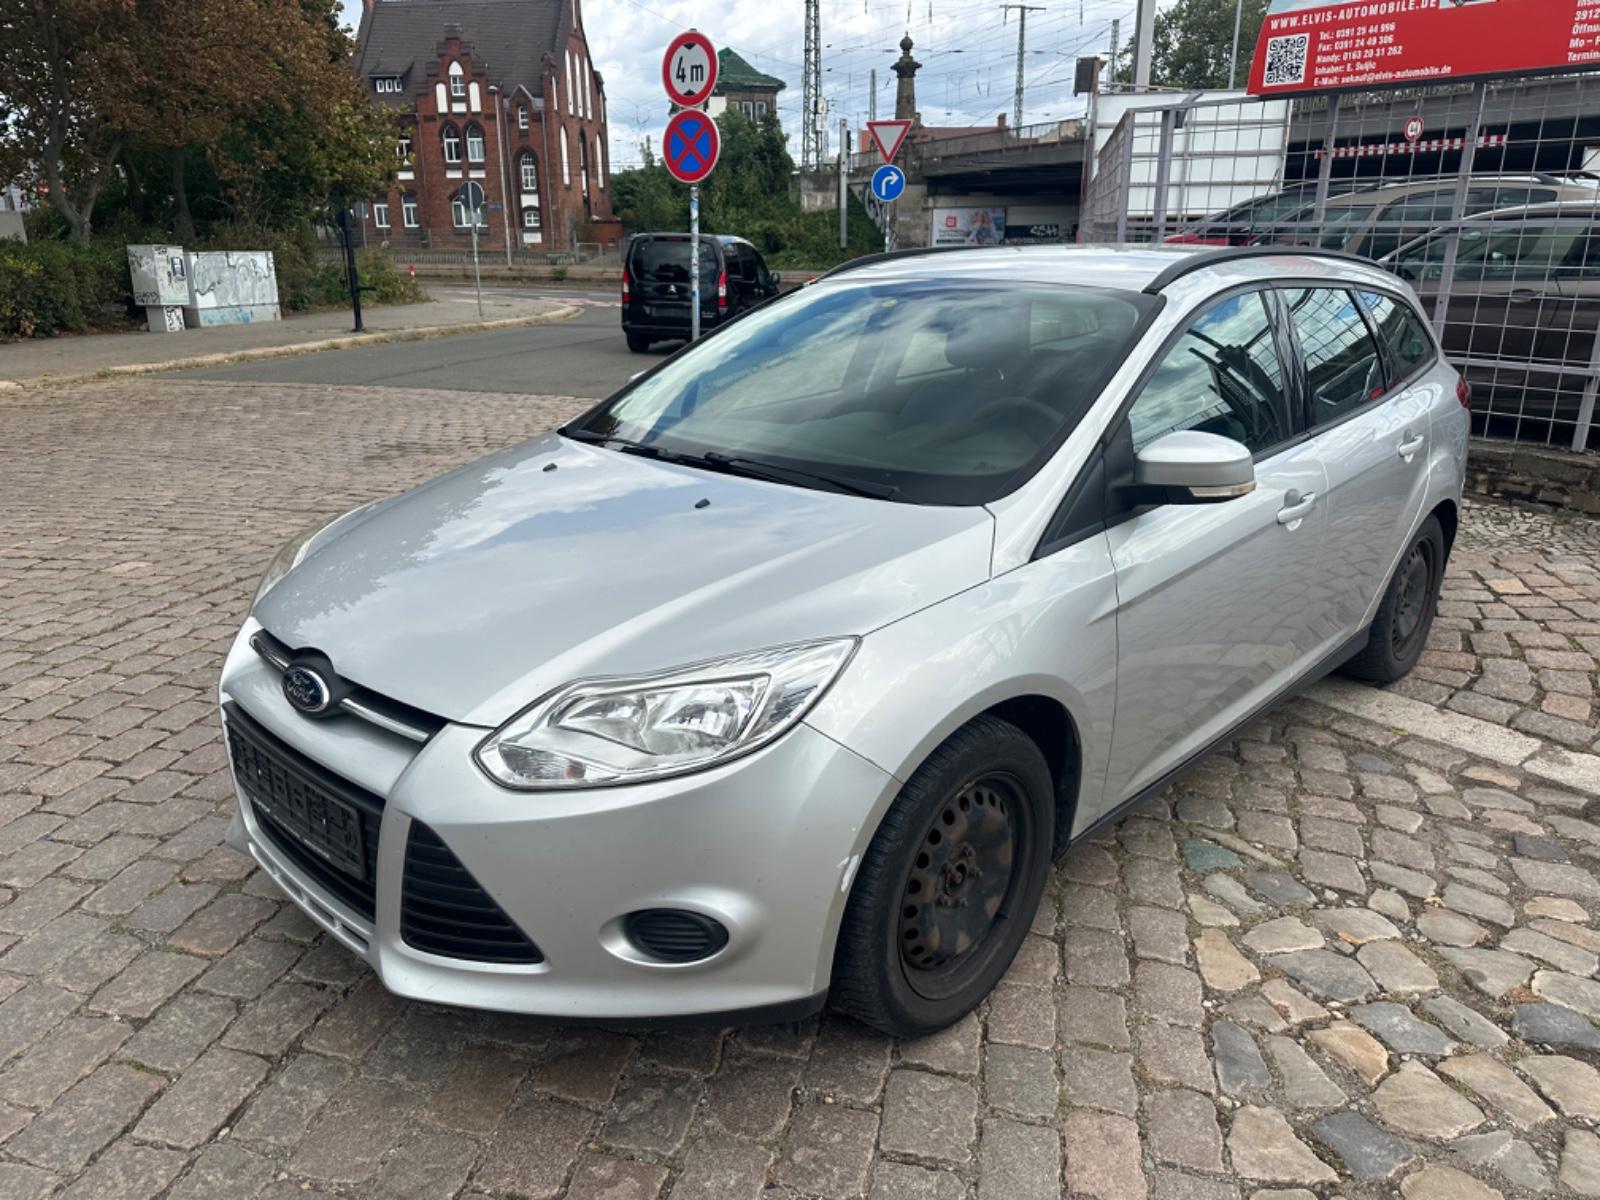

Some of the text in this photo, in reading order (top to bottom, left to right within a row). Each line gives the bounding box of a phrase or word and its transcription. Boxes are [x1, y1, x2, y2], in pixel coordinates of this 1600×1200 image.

[1270, 0, 1436, 30] WWW.ELVIS-AUTOMOBILE.DE
[1368, 24, 1379, 34] 44
[1569, 37, 1585, 48] Mo
[676, 55, 704, 83] 4 m
